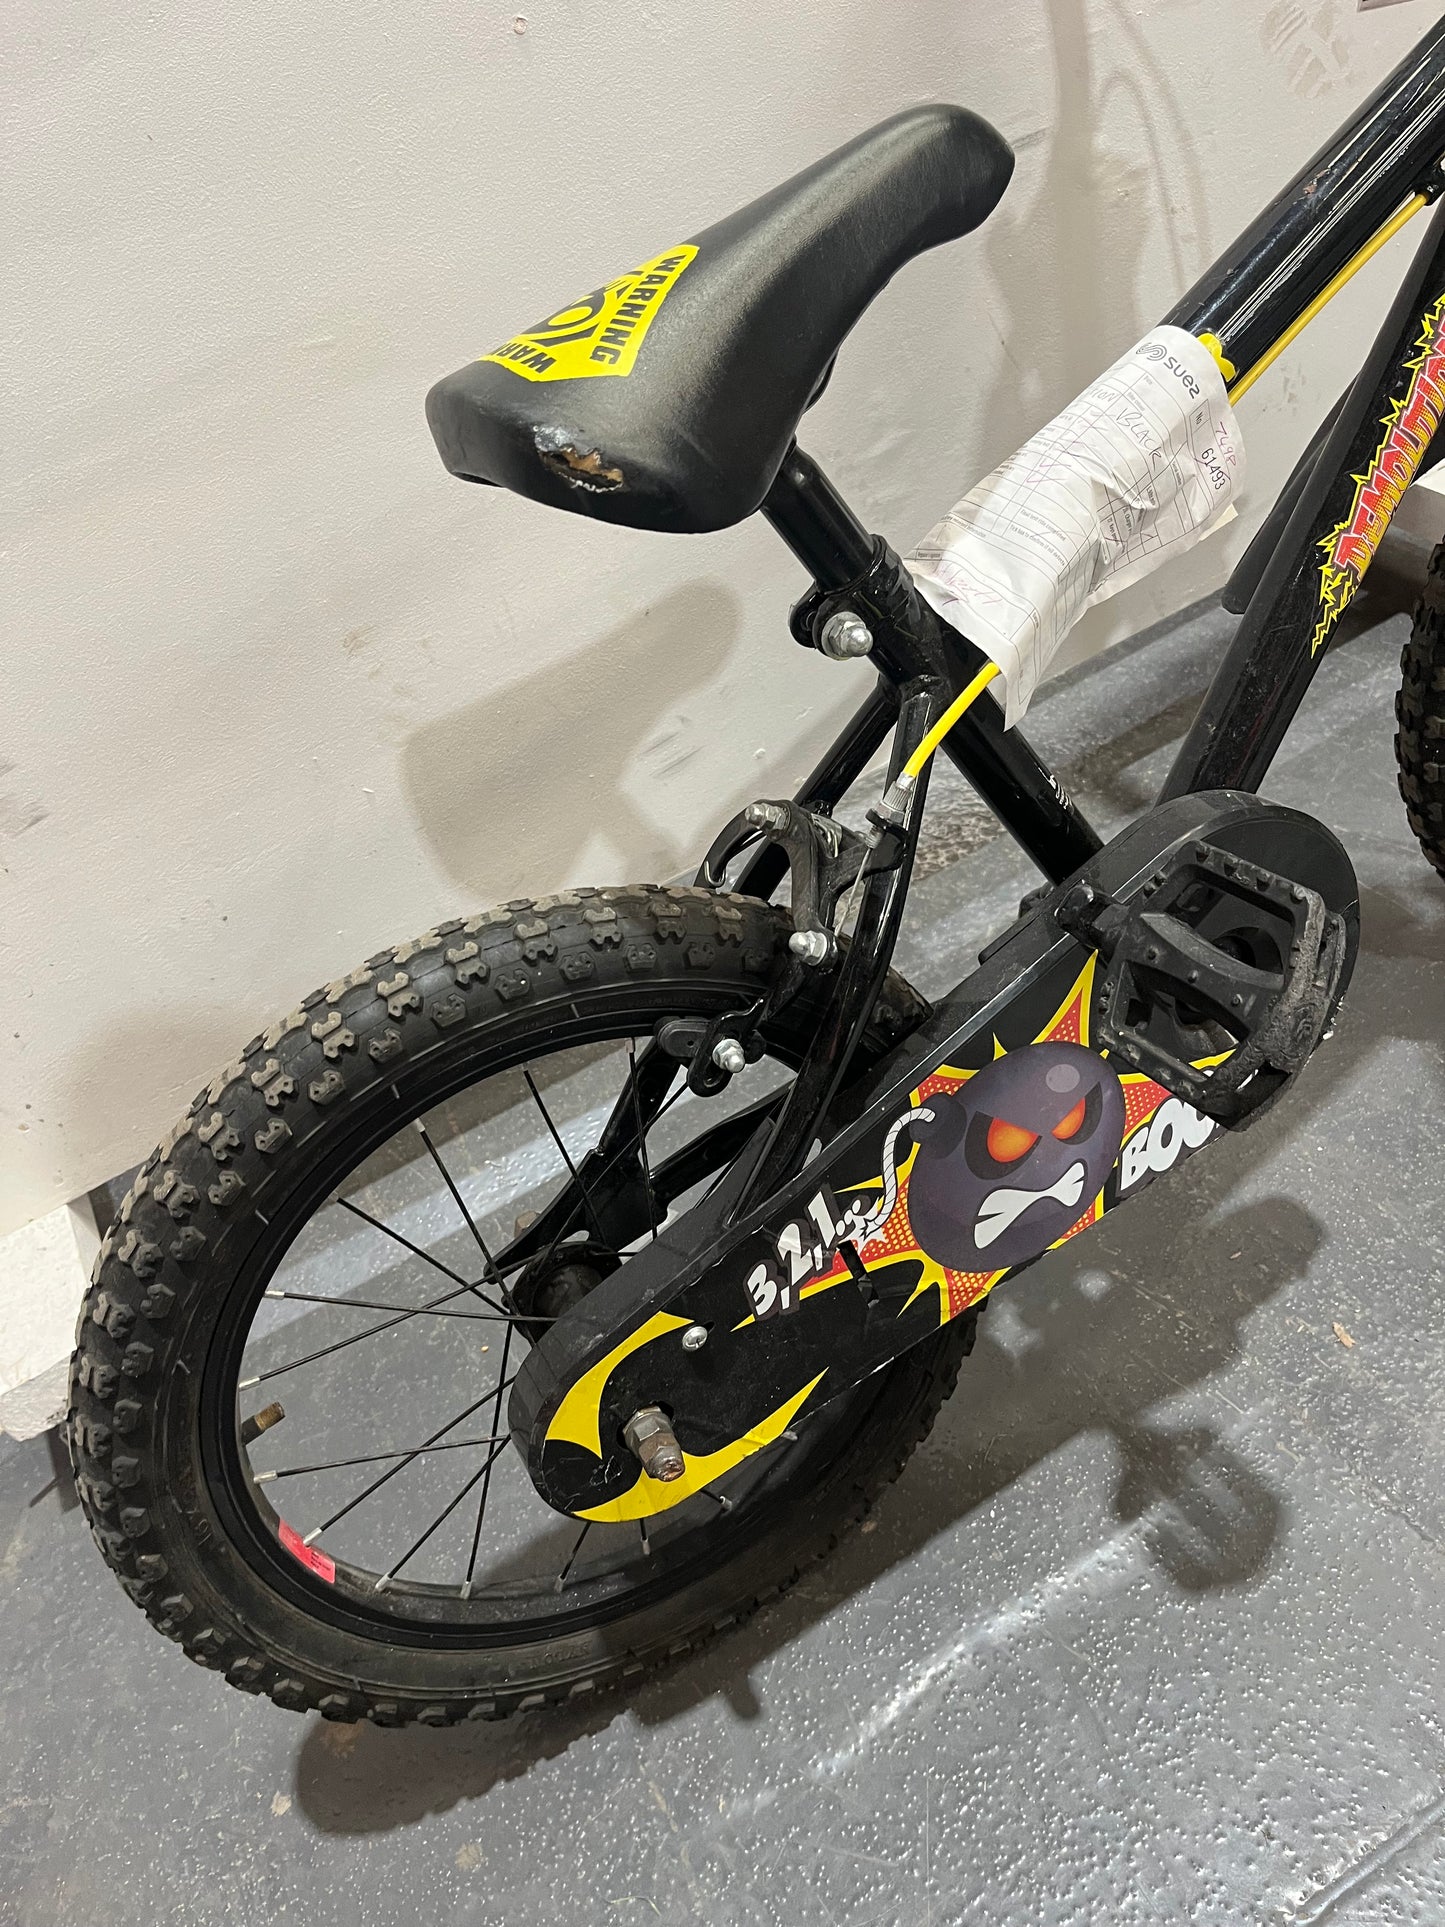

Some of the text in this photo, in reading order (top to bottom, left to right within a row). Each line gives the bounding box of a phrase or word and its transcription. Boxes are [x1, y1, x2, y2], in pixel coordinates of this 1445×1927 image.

[590, 254, 686, 365] WARNING
[491, 343, 557, 374] WAR
[1164, 357, 1201, 399] suez
[1201, 447, 1225, 490] 61493
